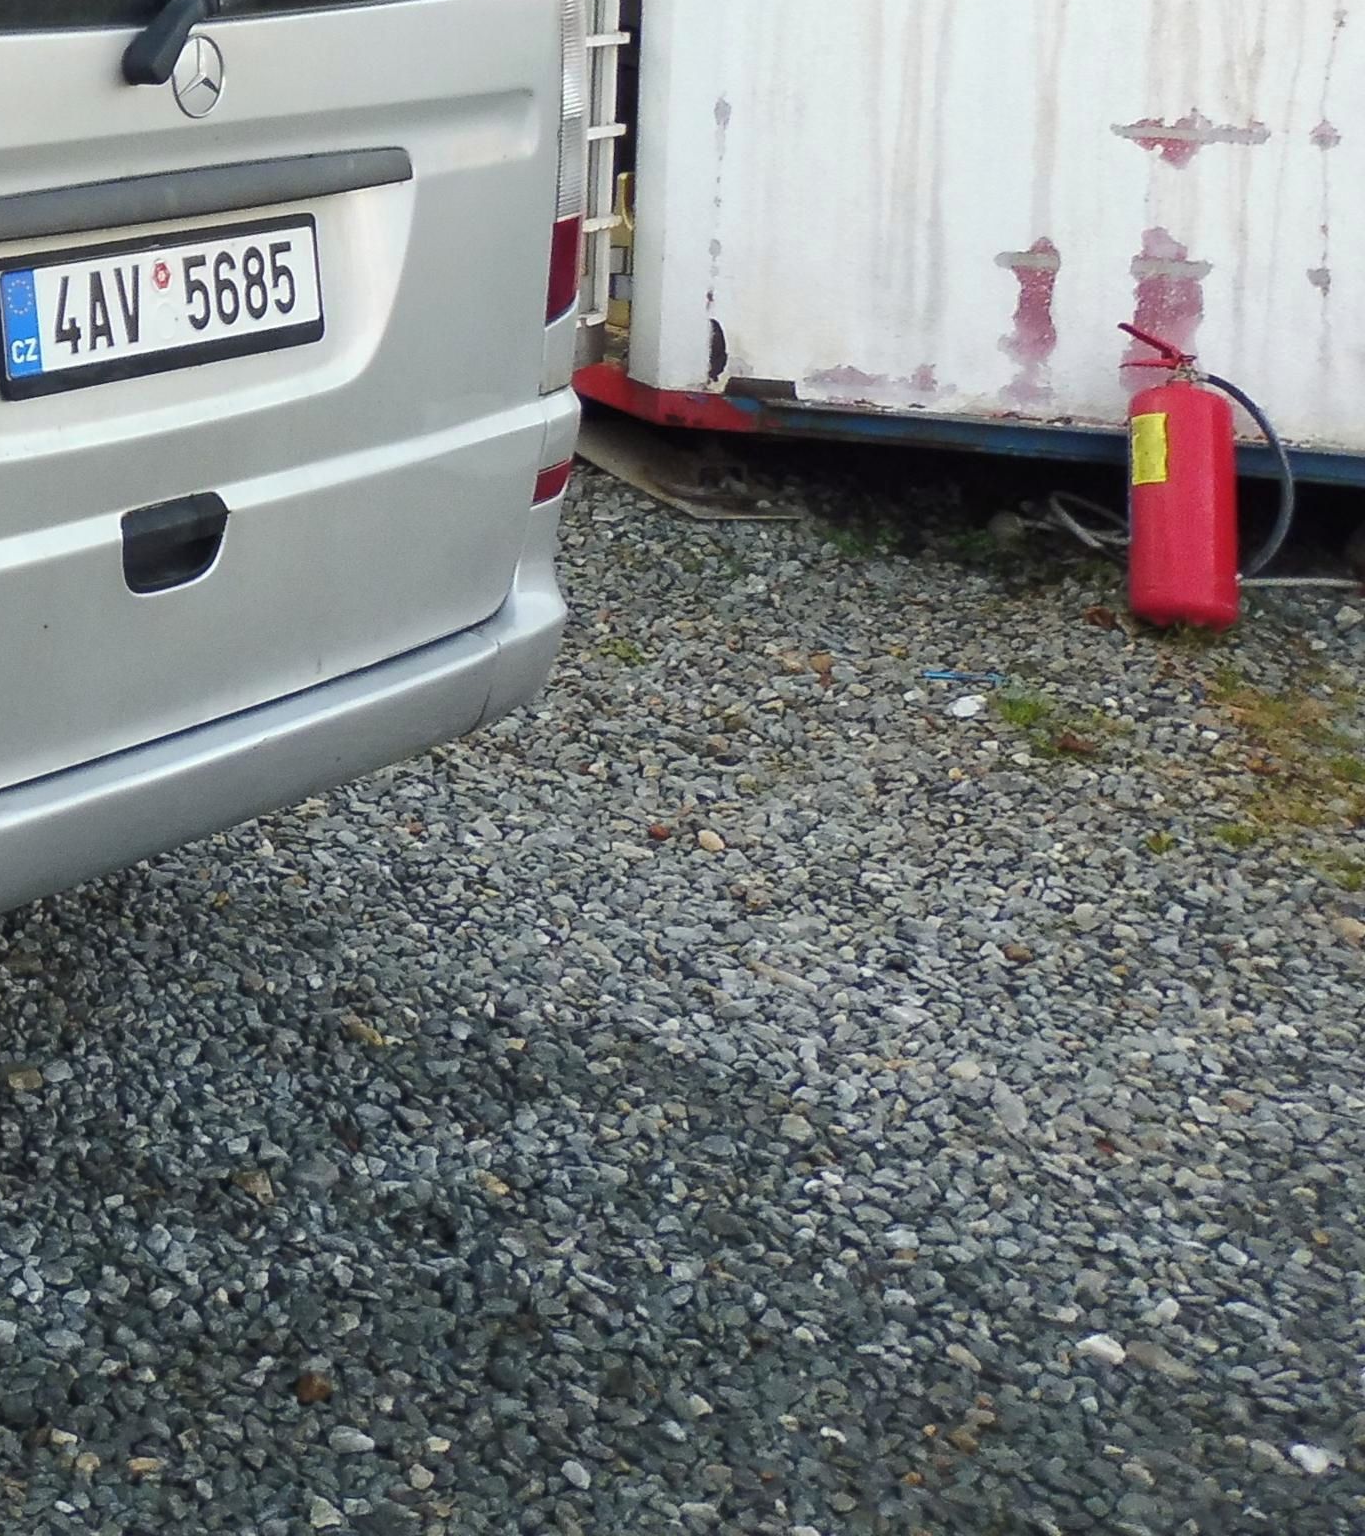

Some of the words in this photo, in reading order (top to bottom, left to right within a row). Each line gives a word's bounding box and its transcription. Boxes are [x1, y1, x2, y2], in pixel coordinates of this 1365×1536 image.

[54, 263, 141, 354] 4AV
[181, 240, 296, 331] 5685
[11, 339, 39, 364] CZ
